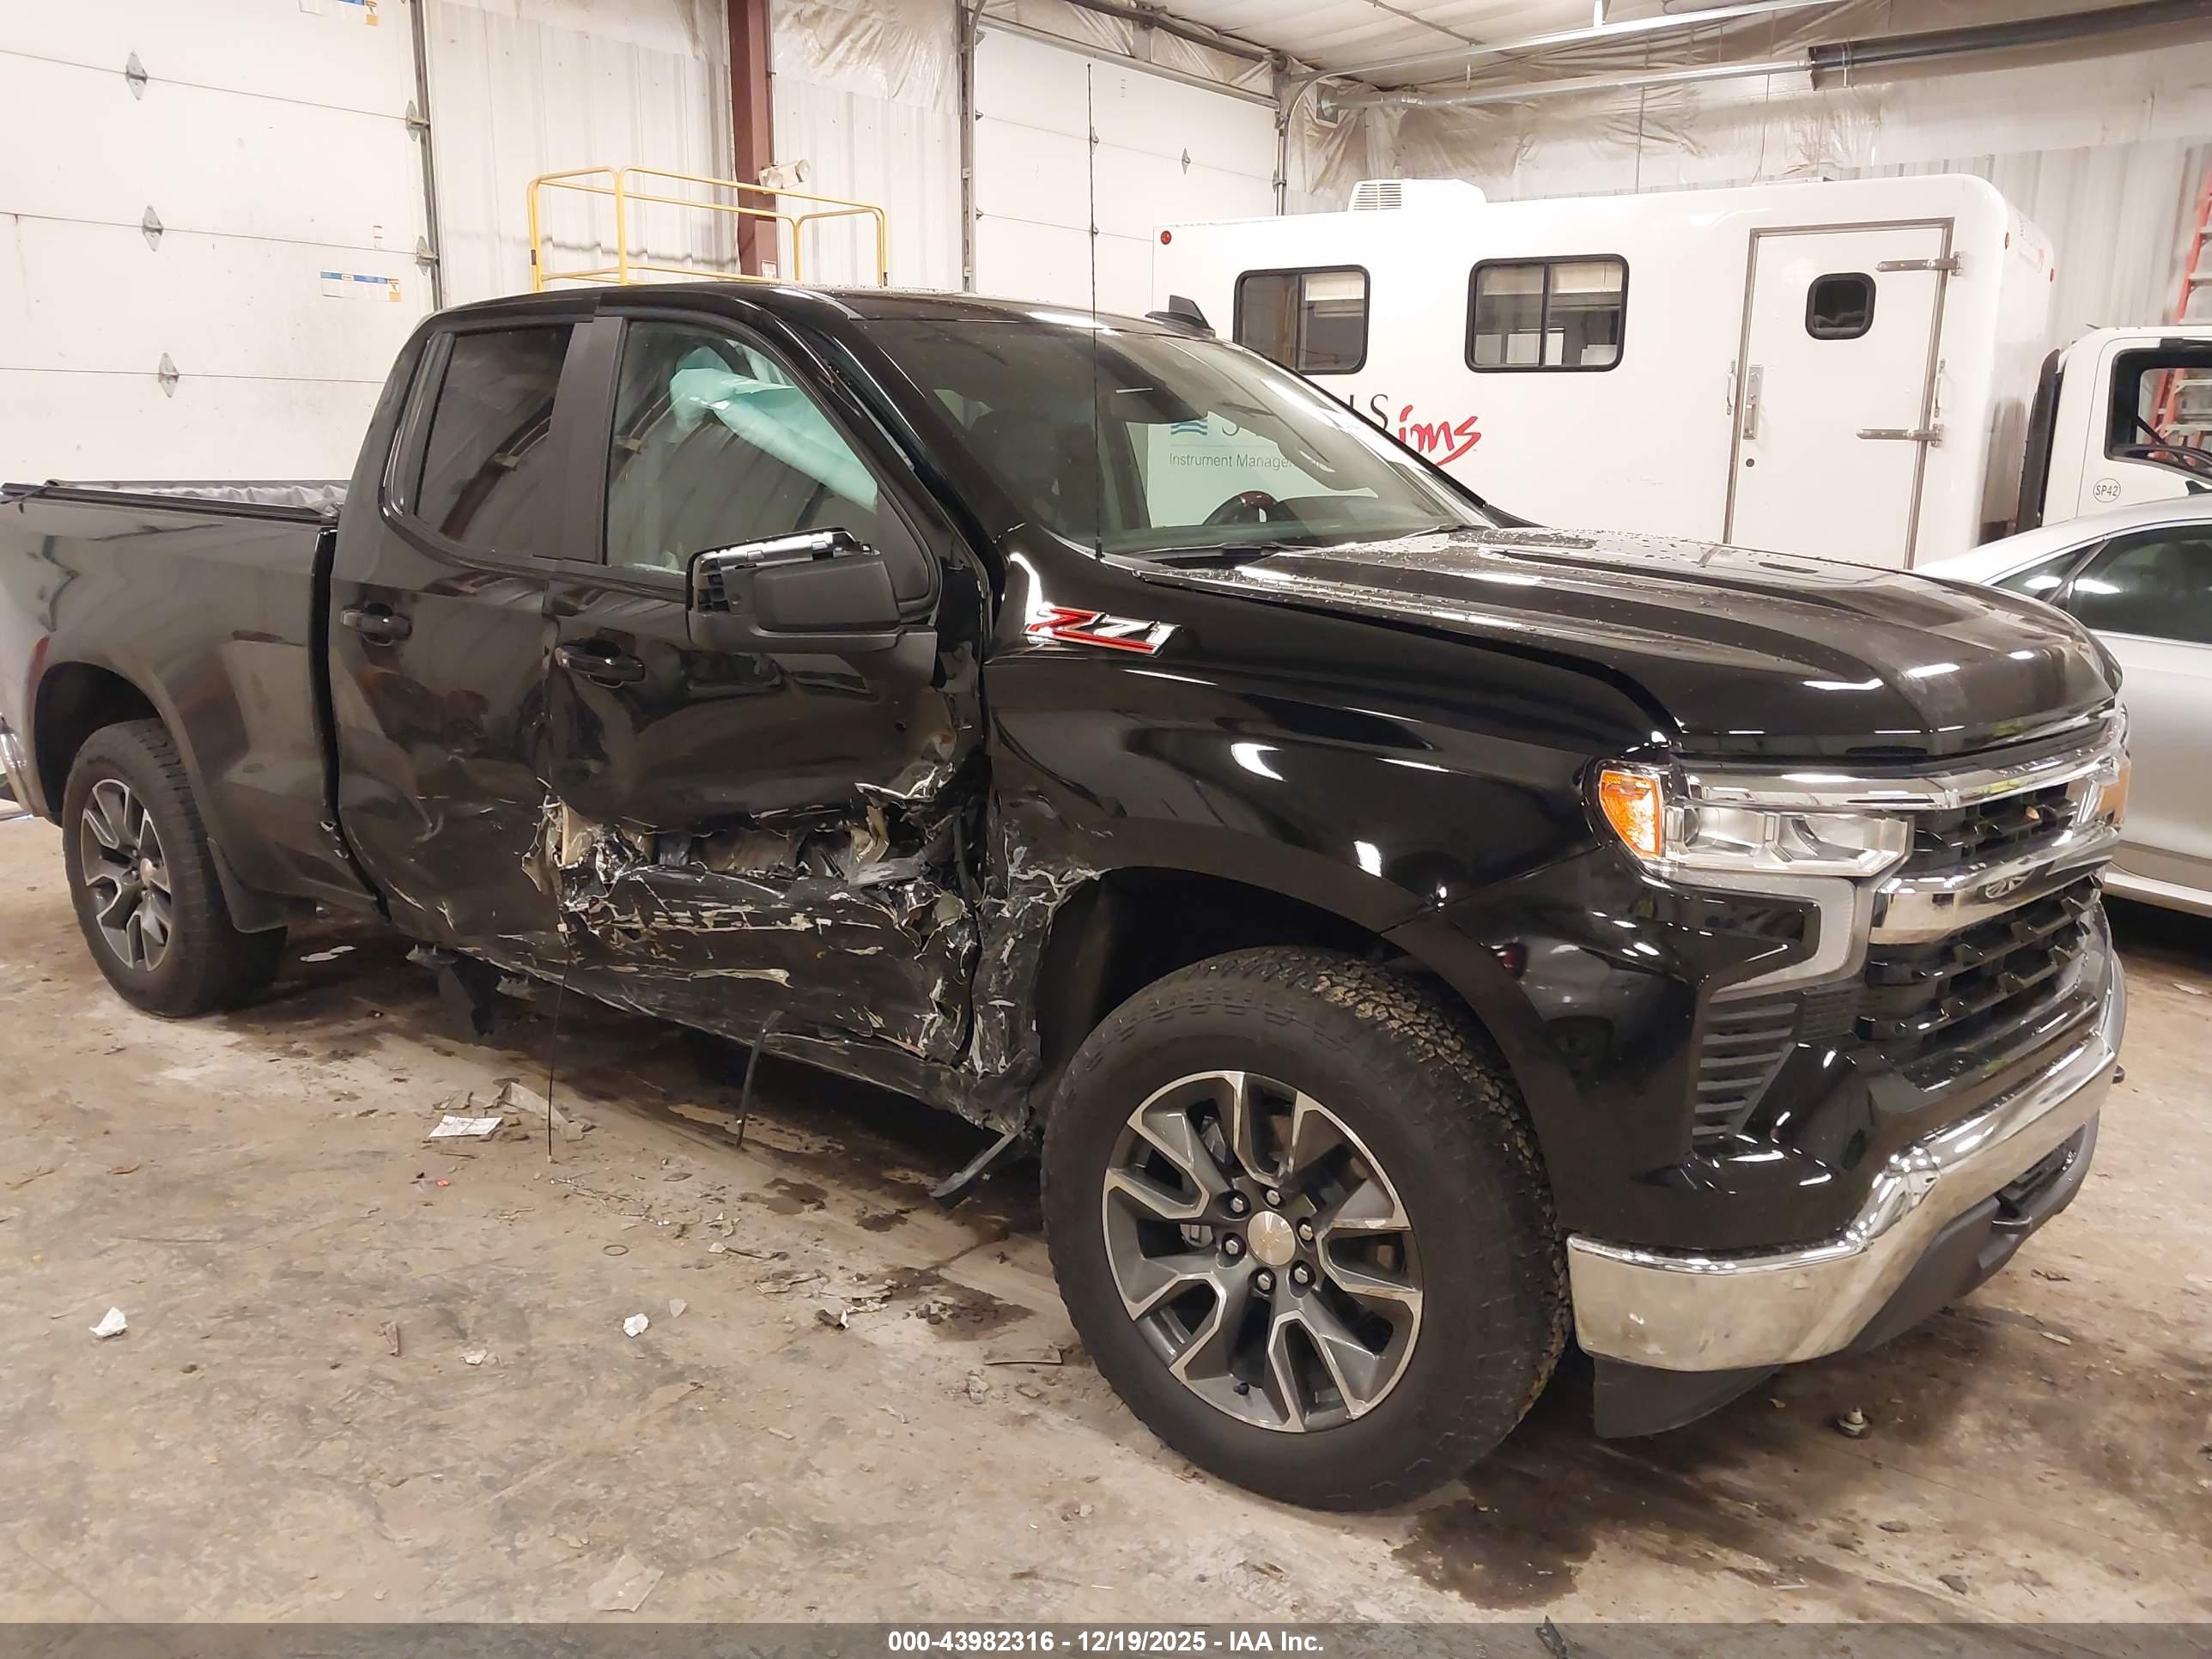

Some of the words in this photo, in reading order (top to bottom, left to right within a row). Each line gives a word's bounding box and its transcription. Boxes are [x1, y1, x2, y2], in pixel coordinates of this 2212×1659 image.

[1170, 453, 1233, 468] Instrument
[2095, 484, 2118, 497] SP42
[1023, 605, 1183, 658] Z71
